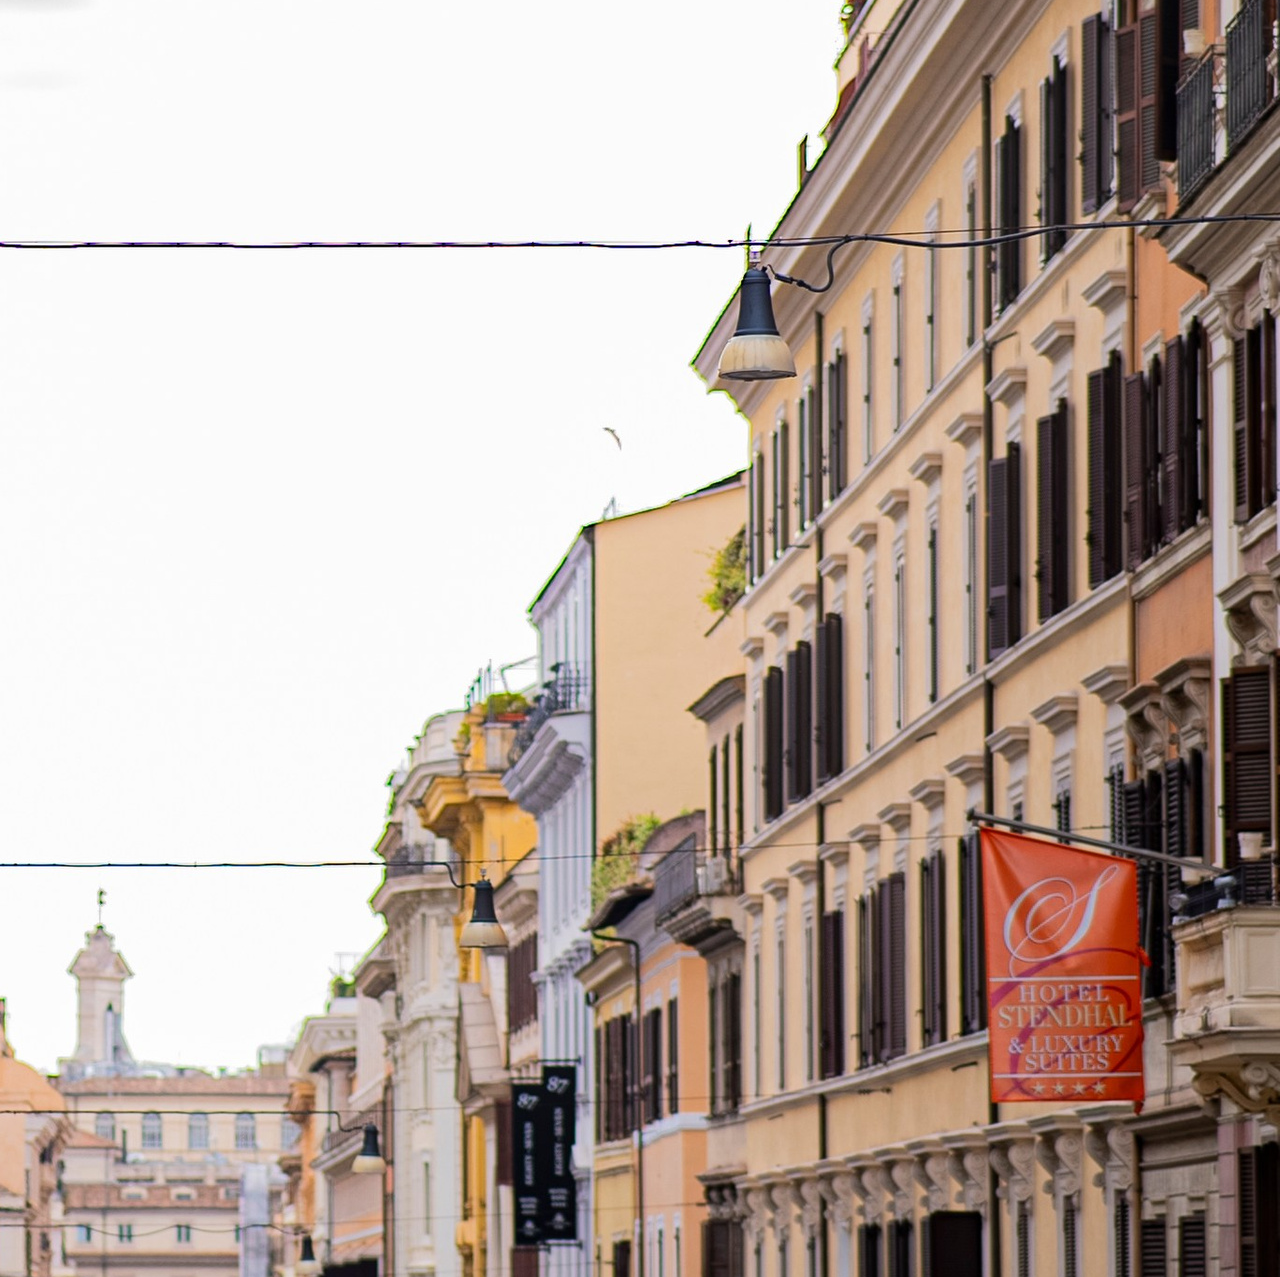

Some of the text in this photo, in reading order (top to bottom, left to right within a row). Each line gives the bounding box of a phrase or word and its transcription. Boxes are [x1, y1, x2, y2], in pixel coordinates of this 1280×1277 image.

[1019, 984, 1109, 1003] HOTEL
[998, 1004, 1133, 1029] STENDHAL
[1008, 1035, 1124, 1054] & LUXURY
[1025, 1053, 1110, 1072] SUITES
[547, 1076, 569, 1093] 87
[517, 1093, 539, 1109] 87
